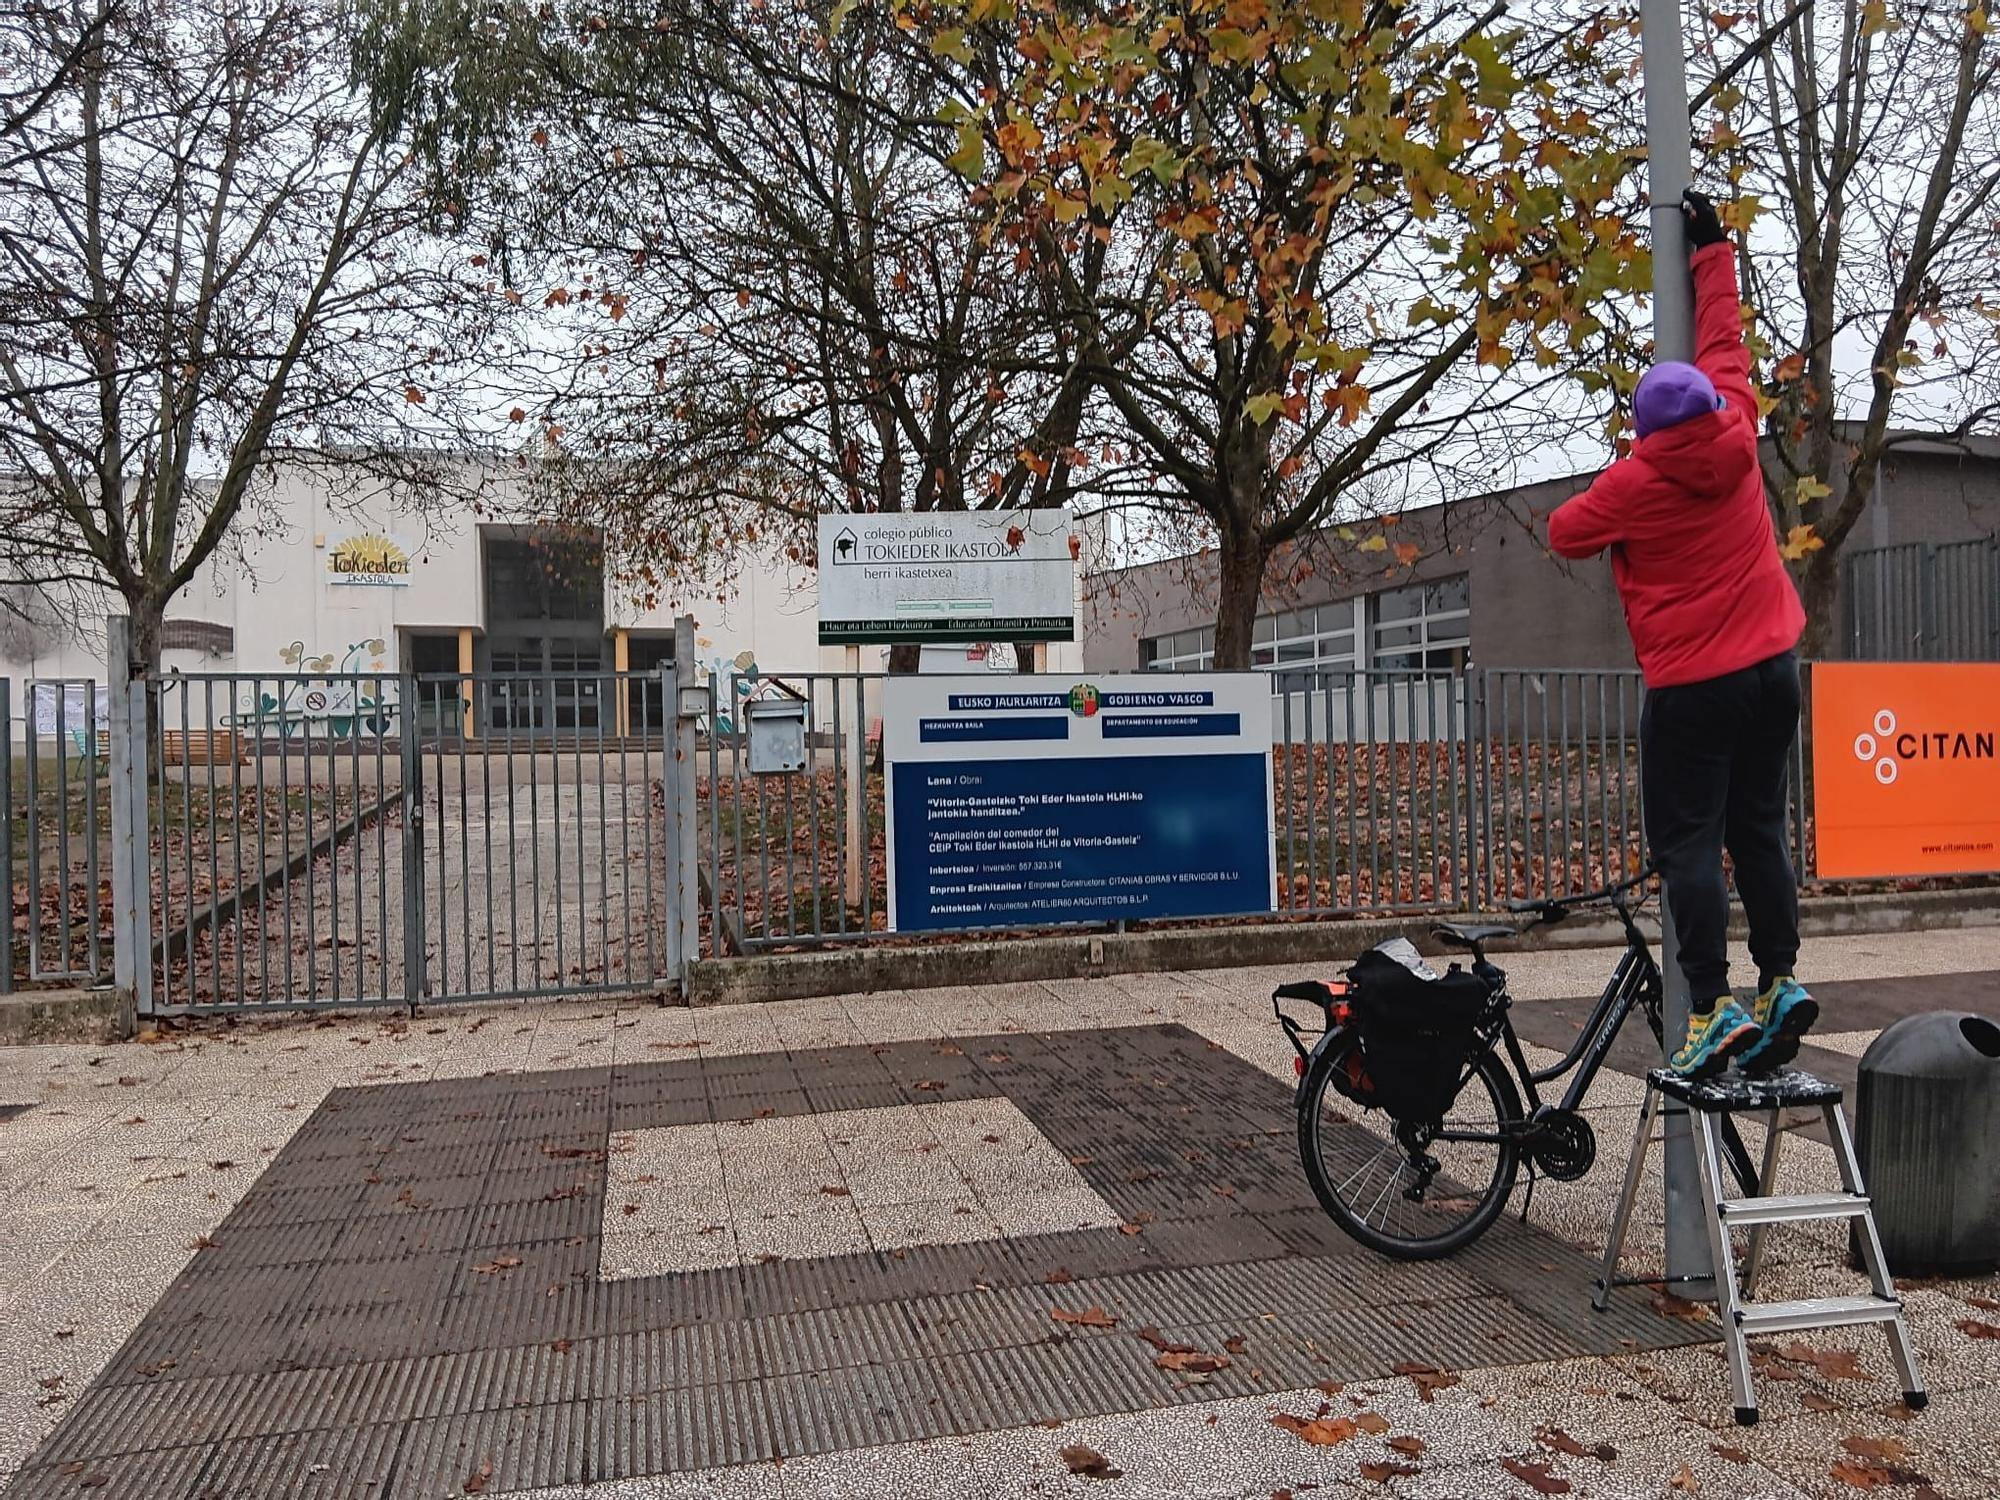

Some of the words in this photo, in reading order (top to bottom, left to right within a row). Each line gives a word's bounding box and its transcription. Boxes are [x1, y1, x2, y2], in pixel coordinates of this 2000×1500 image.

[864, 528, 906, 541] colegio
[909, 526, 952, 541] público
[865, 544, 940, 560] TOKIEDER
[347, 574, 394, 583] IKASTOLA
[864, 567, 891, 579] herri
[895, 567, 952, 579] ikastetxea
[888, 619, 933, 630] Hezkuntza
[948, 619, 991, 629] Educación
[993, 618, 1021, 628] Infantil
[1031, 618, 1066, 627] Primaria
[958, 697, 992, 708] EUSKO
[995, 696, 1061, 708] JAURLARITZA
[1109, 694, 1164, 706] GOBIERNO
[1169, 693, 1204, 704] VASCO
[924, 722, 964, 730] HEZKUNTZA
[1106, 718, 1153, 726] DEPARTAMENTO
[1163, 716, 1198, 725] EDUCACIÓN
[1896, 732, 1994, 759] CITAN
[927, 776, 951, 785] Lana
[1018, 794, 1039, 805] Toki
[1041, 794, 1063, 804] Eder
[1066, 793, 1104, 803] Ikastola
[1106, 792, 1143, 802] HLHI-ko
[928, 808, 968, 820] jantokia
[987, 830, 1001, 840] del
[1003, 830, 1043, 840] comedor
[1045, 827, 1059, 837] del
[929, 843, 951, 853] CEIP
[954, 842, 973, 852] Toki
[975, 841, 997, 851] Eder
[999, 840, 1034, 850] Ikastola
[1036, 838, 1058, 848] HLHI
[1060, 838, 1071, 847] de
[929, 865, 974, 875] Inbertsioa
[930, 886, 966, 895] Enpresa
[1028, 880, 1060, 890] Empresa
[1109, 875, 1143, 886] CITANIAS
[1145, 874, 1171, 884] OBRAS
[1179, 872, 1218, 882] SERVICIOS
[930, 903, 982, 914] Arkitektoak
[1074, 896, 1127, 906] ARQUITECTOS
